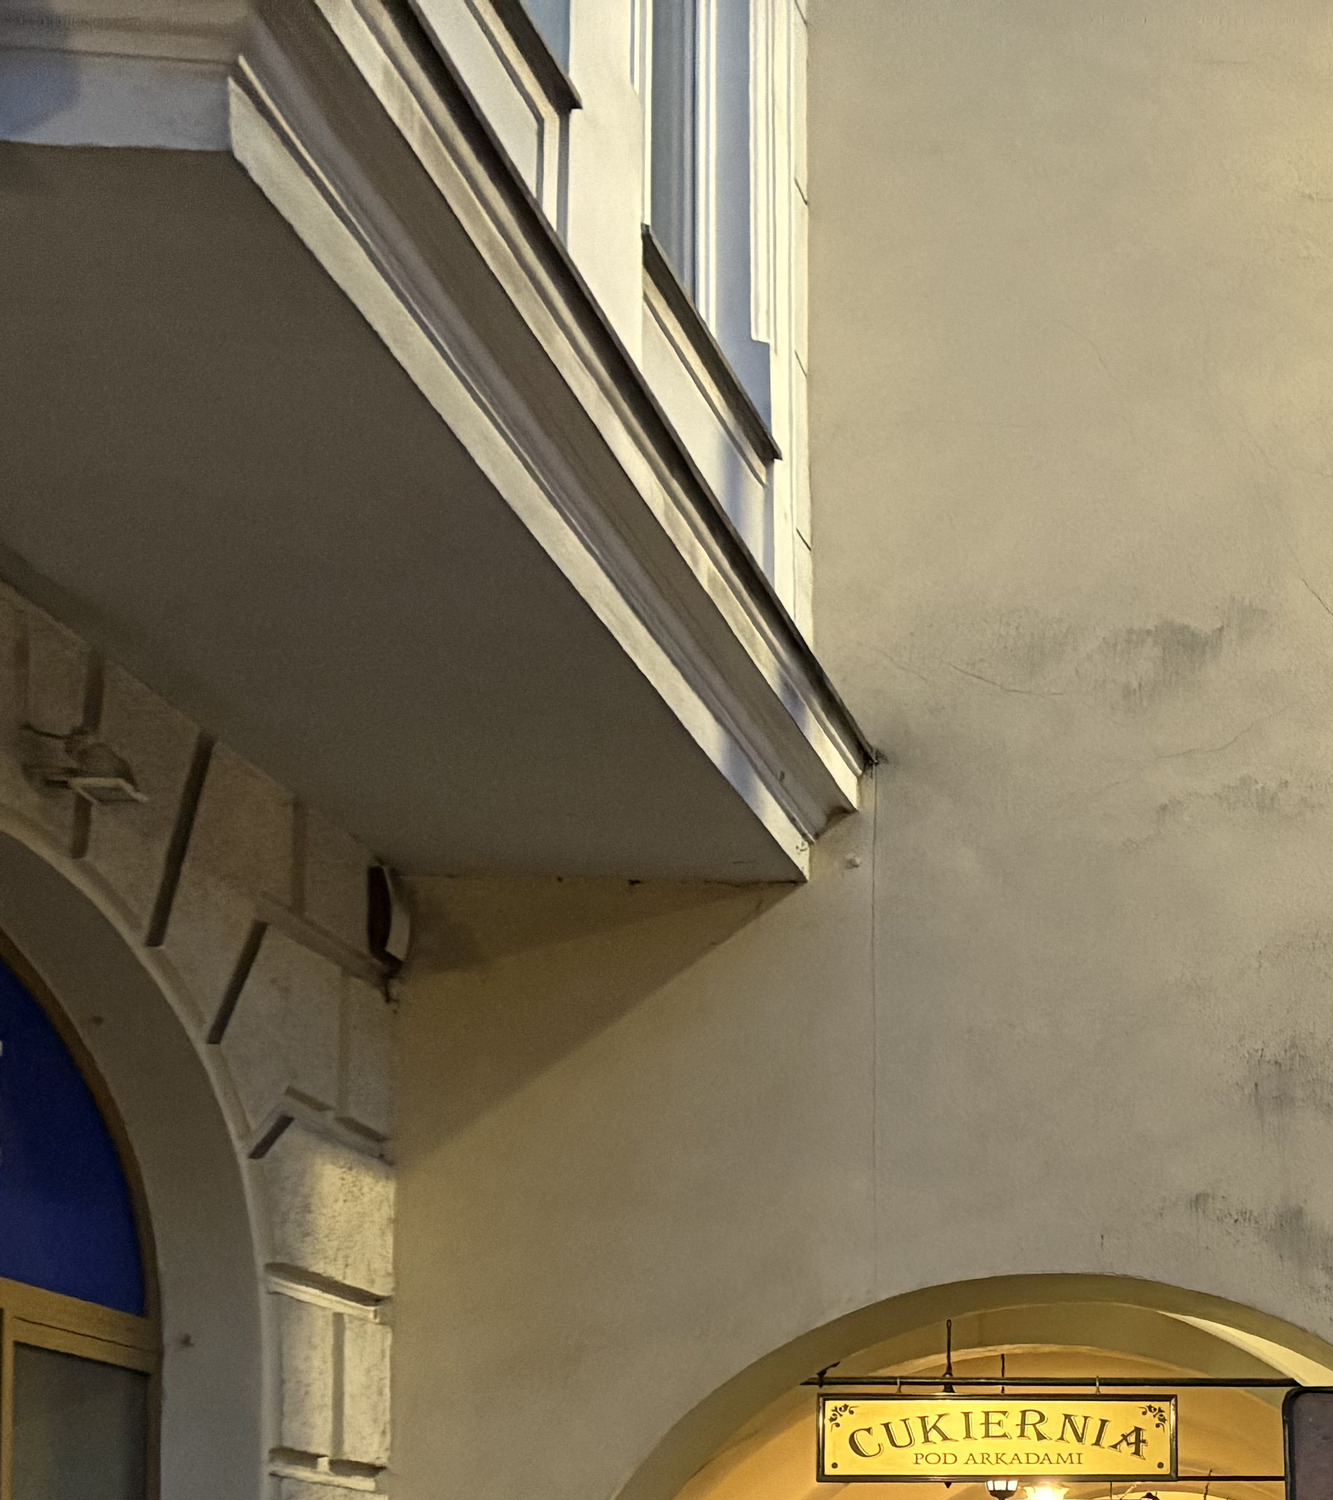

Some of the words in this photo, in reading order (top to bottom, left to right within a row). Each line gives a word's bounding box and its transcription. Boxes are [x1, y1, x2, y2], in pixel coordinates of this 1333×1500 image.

[849, 1408, 1150, 1460] CUKIERNIA
[913, 1452, 958, 1466] POD
[963, 1452, 1084, 1466] ARKADAMI
